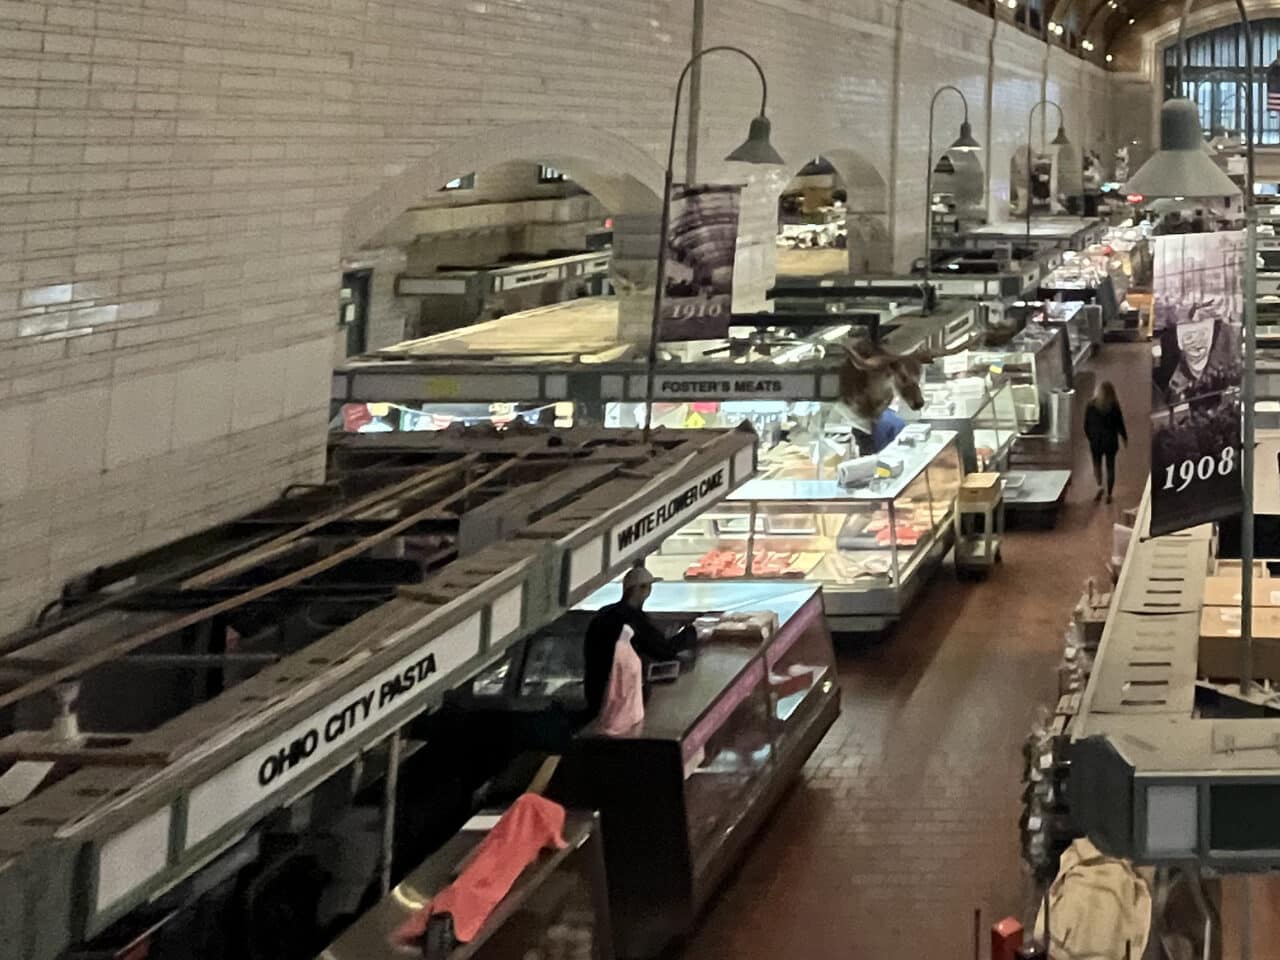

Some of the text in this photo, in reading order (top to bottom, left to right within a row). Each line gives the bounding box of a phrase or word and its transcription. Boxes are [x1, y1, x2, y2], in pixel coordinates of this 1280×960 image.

[662, 380, 782, 393] FOSTER'S MEATS
[1161, 446, 1235, 492] 1908
[617, 468, 724, 552] WHITE FLOWER CAKE
[258, 652, 437, 786] OHIO CITY PASTA
